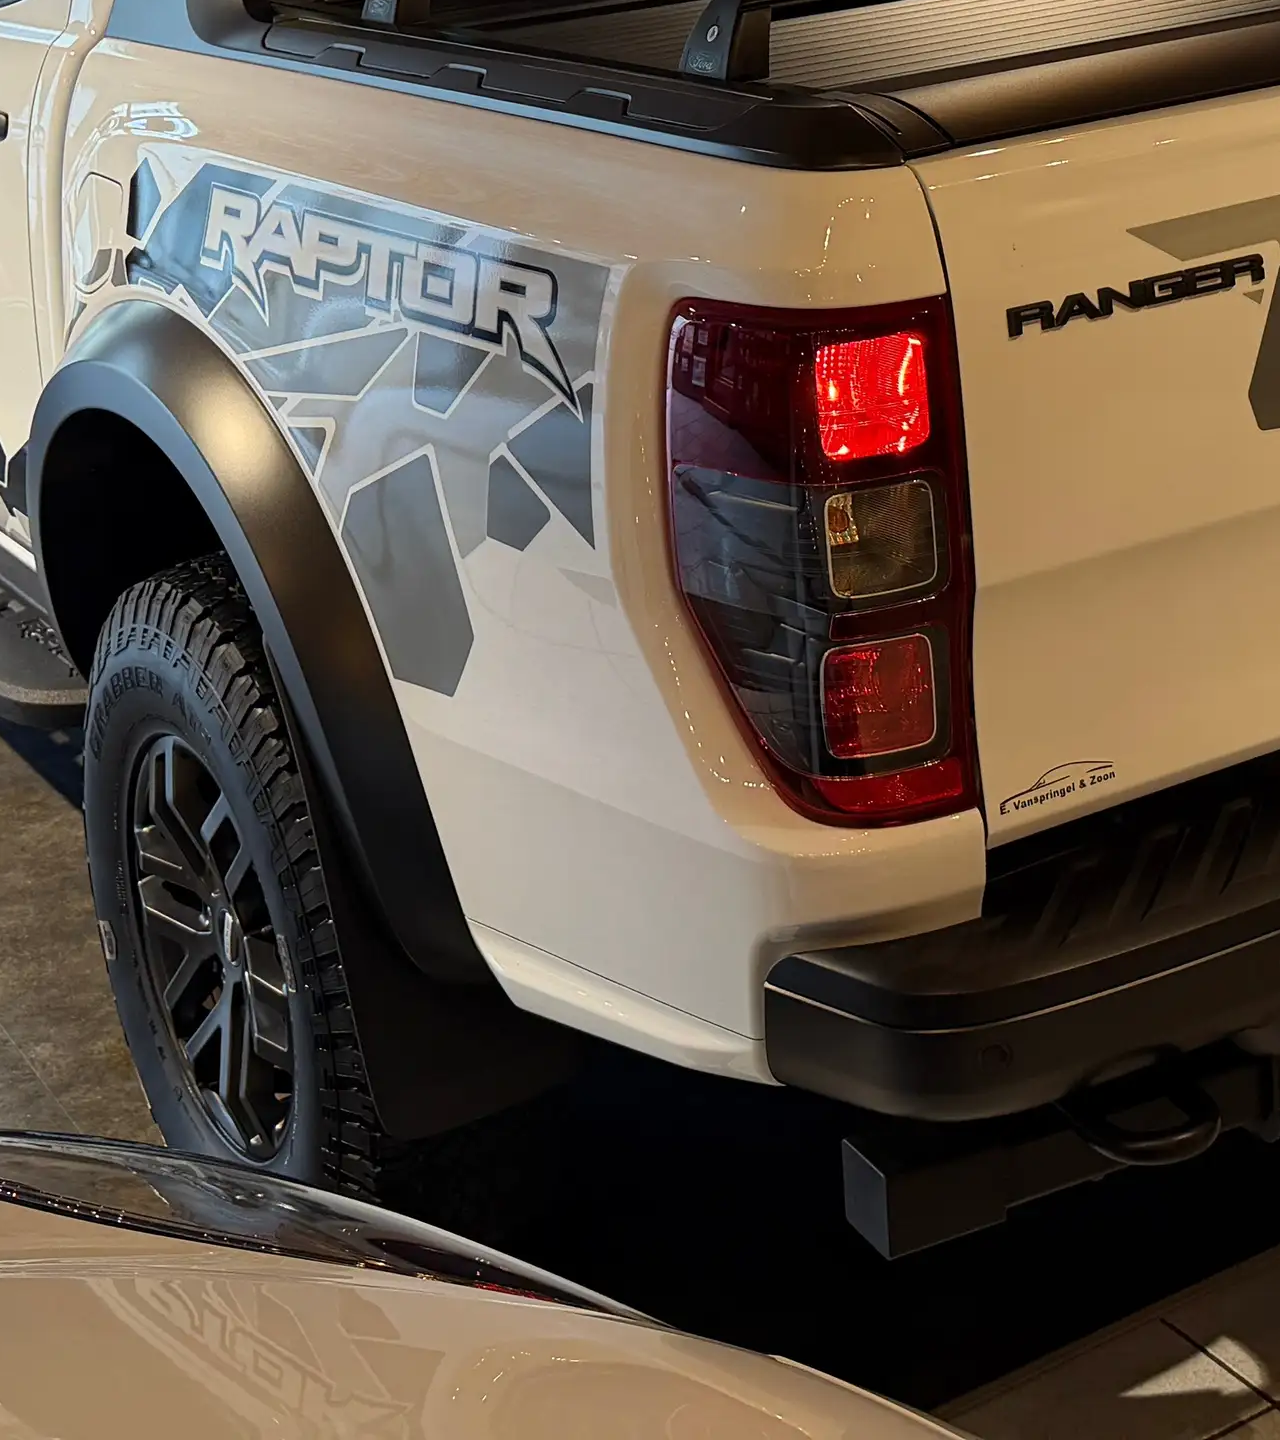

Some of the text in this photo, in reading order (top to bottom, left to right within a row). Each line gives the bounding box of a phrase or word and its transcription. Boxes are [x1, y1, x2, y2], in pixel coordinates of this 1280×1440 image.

[200, 180, 584, 423] RAPTOR
[1006, 252, 1266, 340] RANGER
[999, 770, 1116, 816] E. Vanspringel & Zoon
